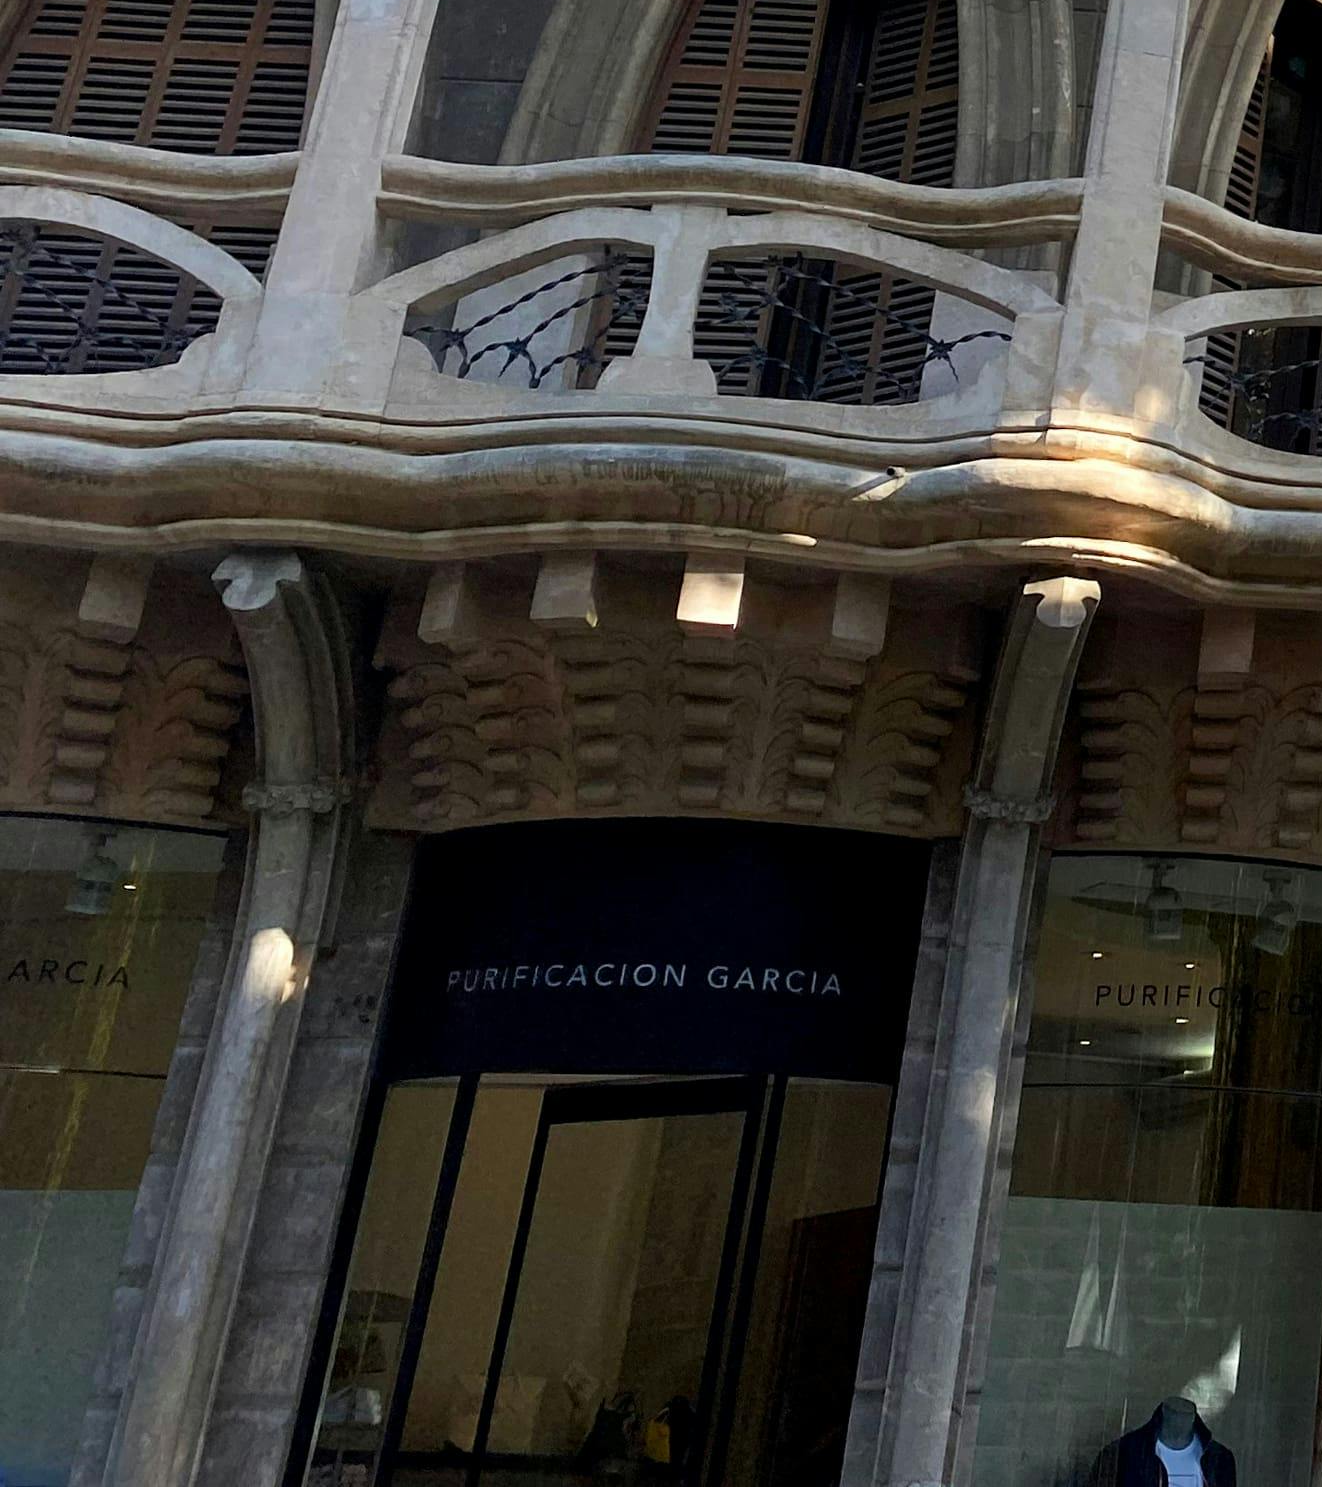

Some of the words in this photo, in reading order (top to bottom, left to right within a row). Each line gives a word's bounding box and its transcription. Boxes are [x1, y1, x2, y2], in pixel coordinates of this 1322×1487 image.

[8, 959, 128, 988] ARCIA
[446, 963, 688, 993] PURIFICACION
[707, 965, 842, 996] GARCIA
